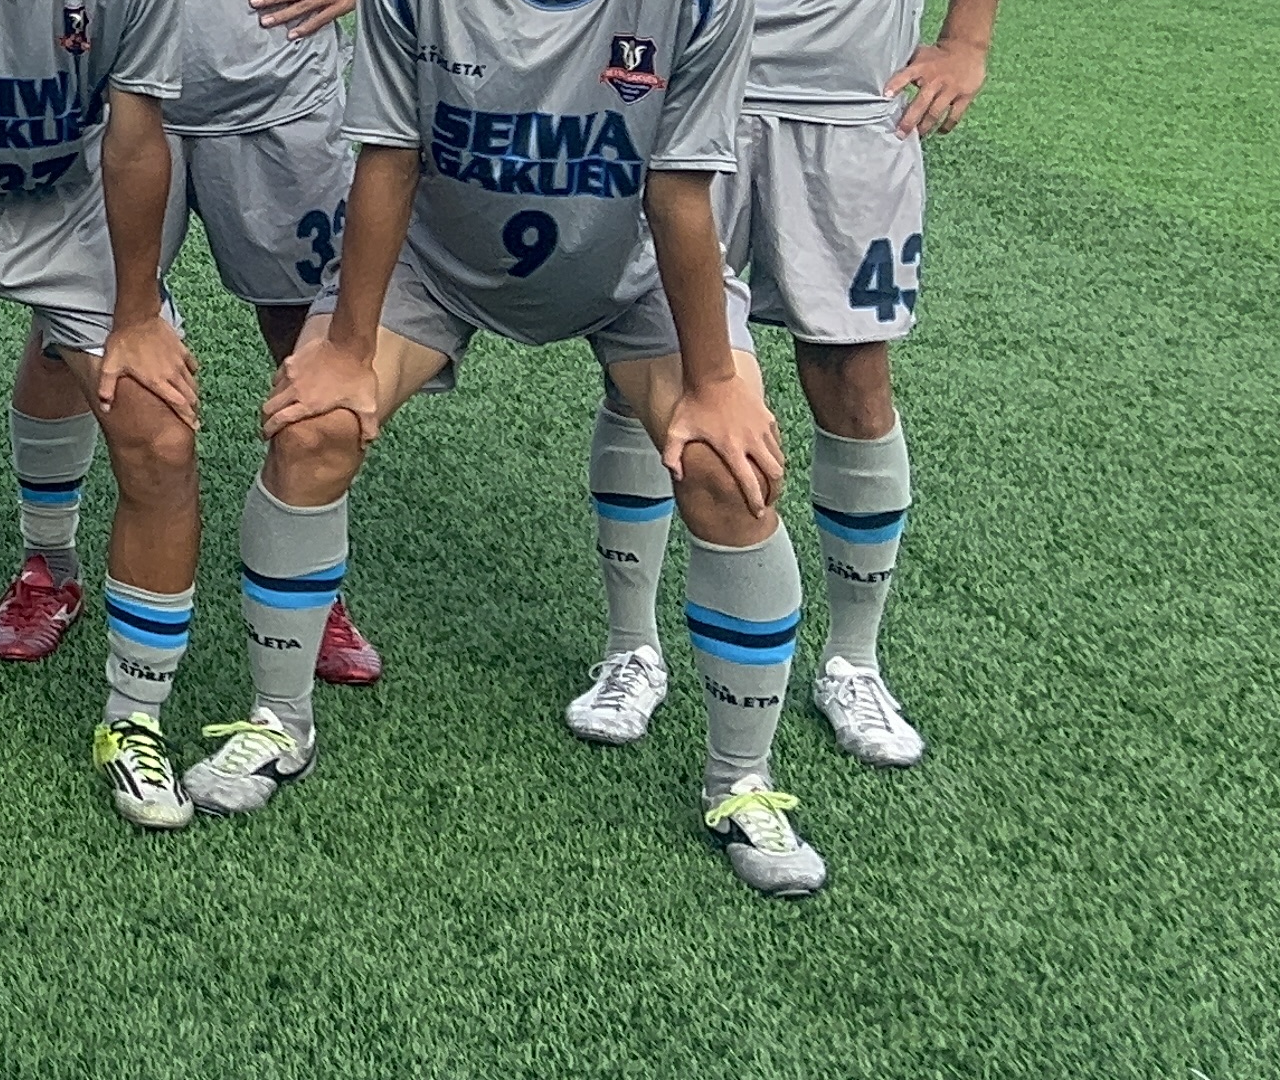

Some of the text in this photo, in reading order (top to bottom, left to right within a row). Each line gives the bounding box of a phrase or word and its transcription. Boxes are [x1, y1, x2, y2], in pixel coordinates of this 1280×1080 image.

[431, 100, 643, 162] SEIWA
[431, 140, 644, 199] GAKUEN
[296, 199, 346, 285] 3
[502, 210, 559, 278] 9
[597, 546, 639, 563] LETA
